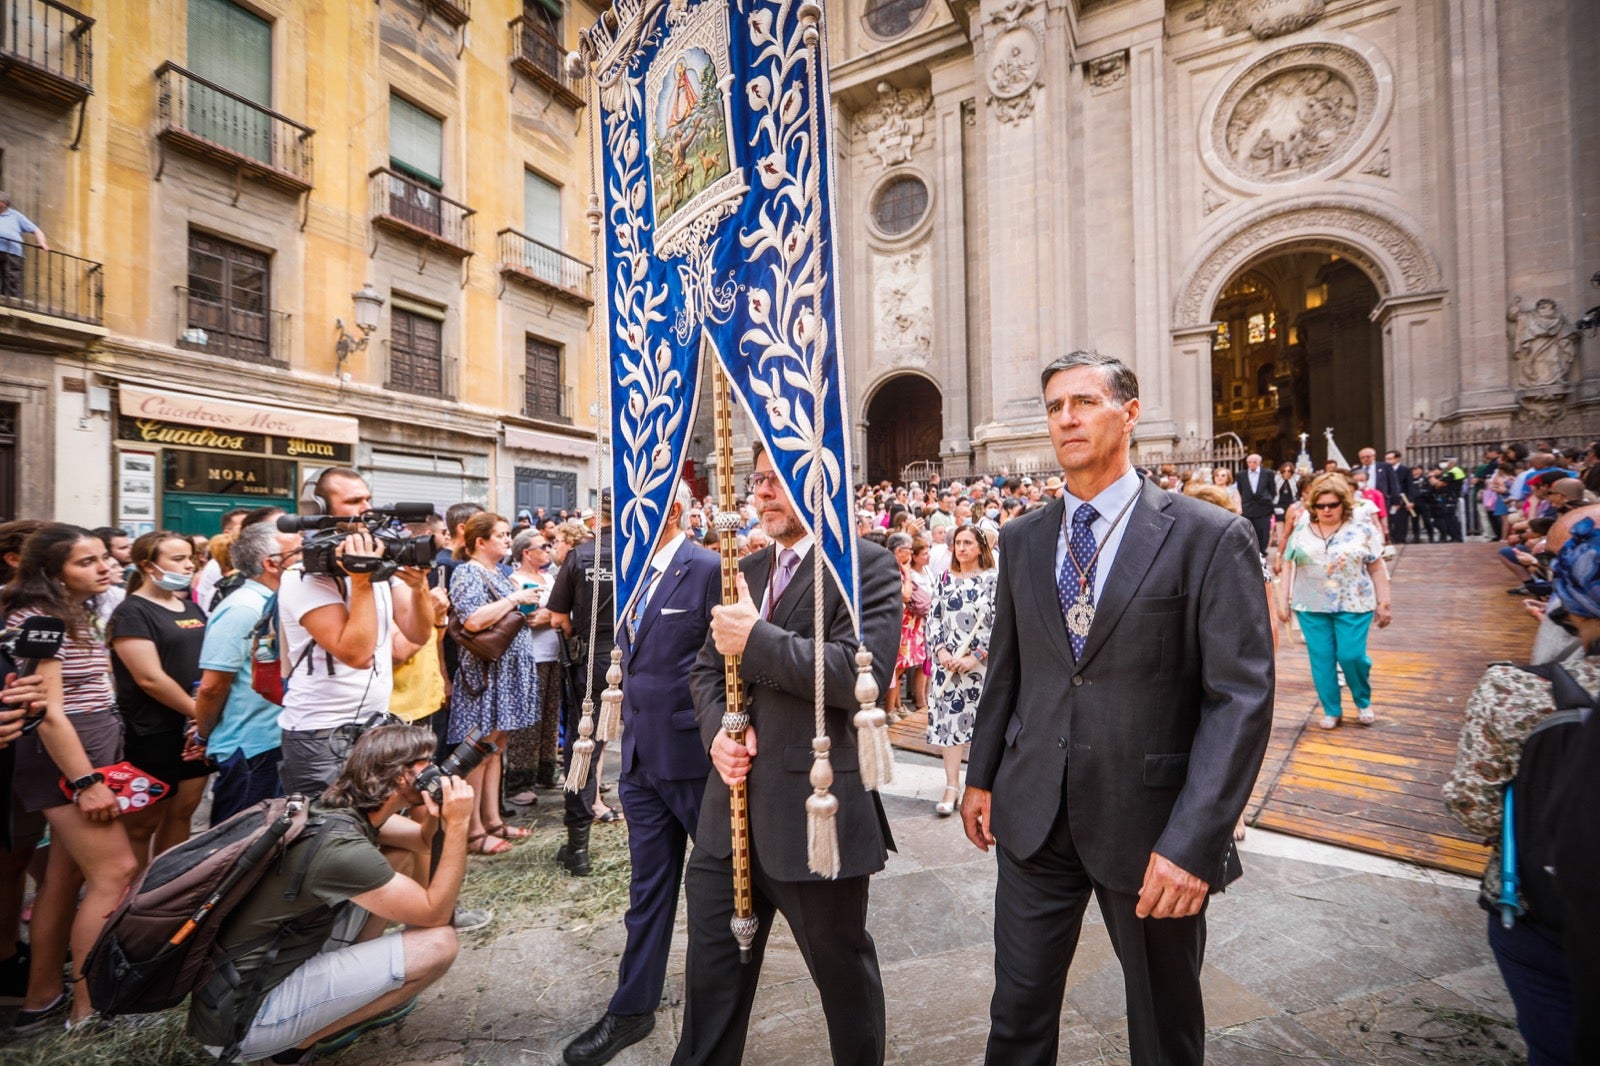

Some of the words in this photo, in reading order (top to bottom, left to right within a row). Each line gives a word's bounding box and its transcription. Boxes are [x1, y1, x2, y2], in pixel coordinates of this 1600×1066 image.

[140, 396, 234, 424] Cuadros
[240, 411, 296, 433] Mora
[135, 420, 245, 449] Cuadros
[287, 437, 335, 456] Mora
[208, 468, 256, 482] MORA
